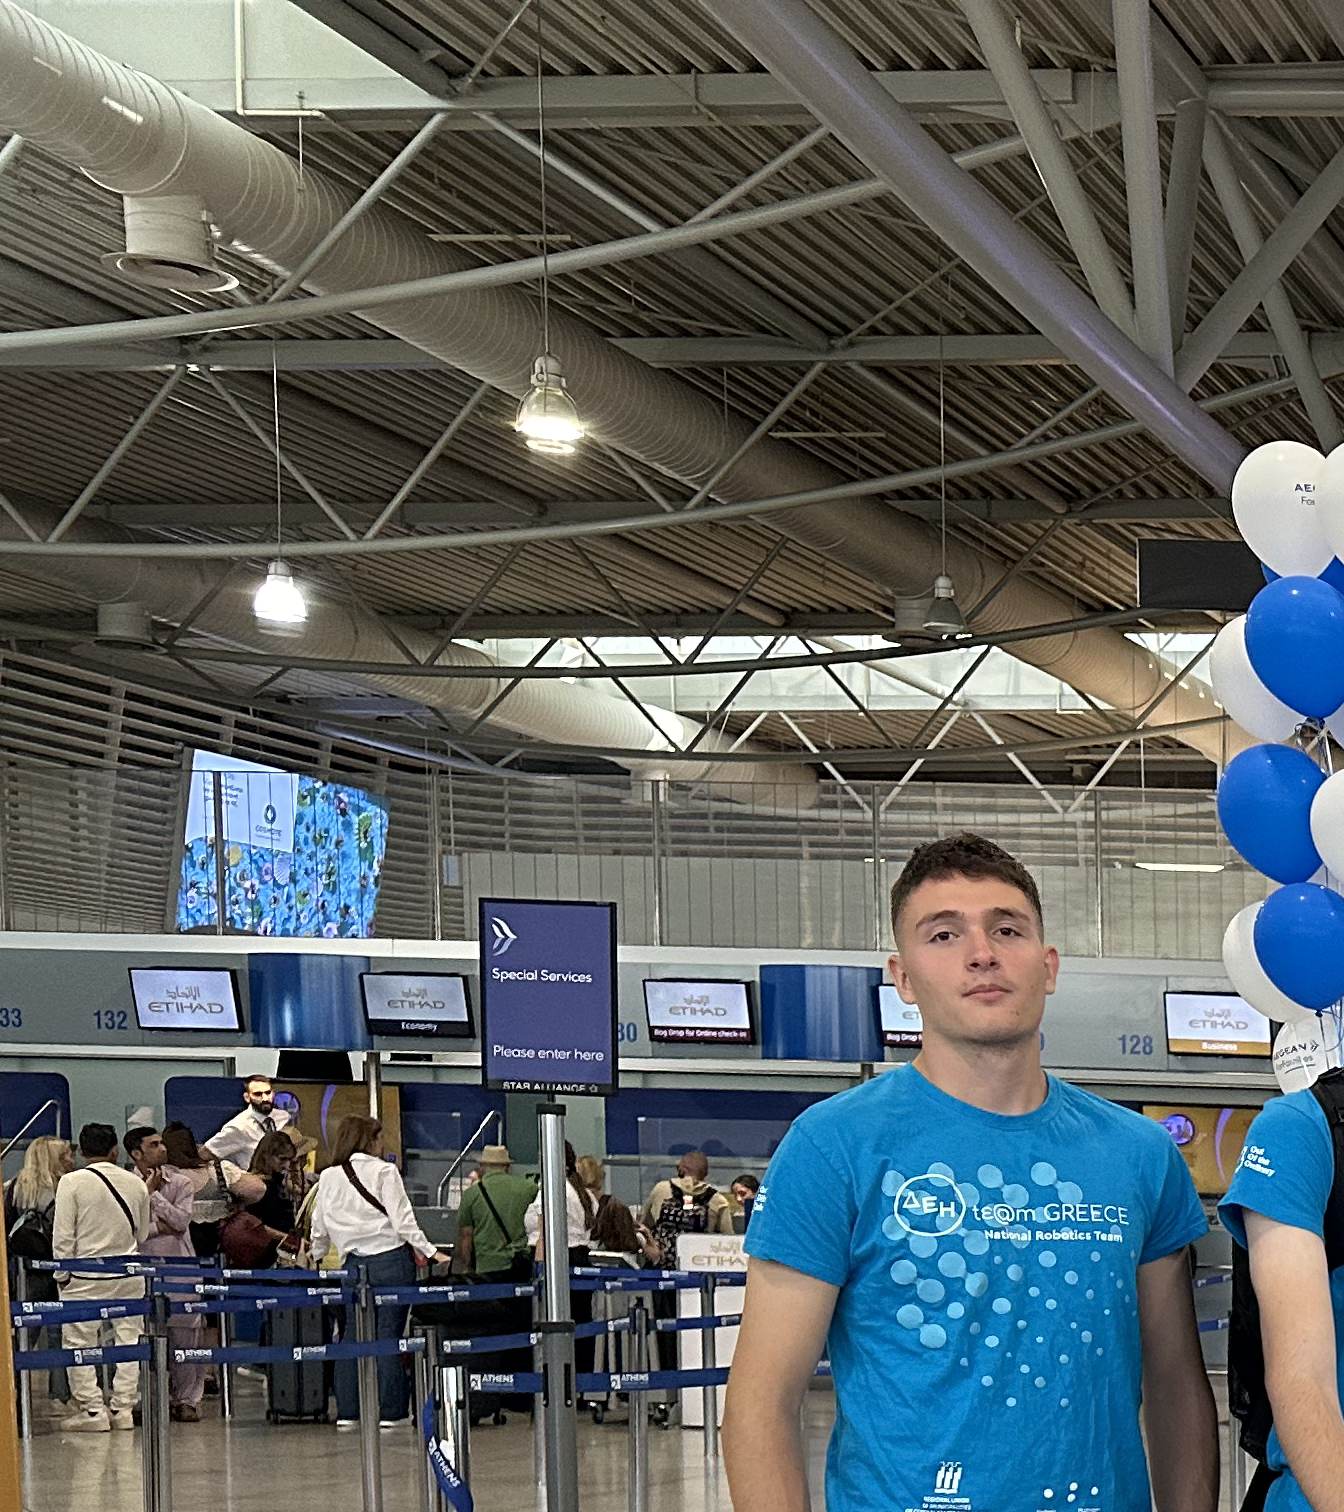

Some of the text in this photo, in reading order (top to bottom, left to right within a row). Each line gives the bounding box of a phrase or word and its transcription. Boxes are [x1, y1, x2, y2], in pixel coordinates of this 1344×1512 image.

[492, 968, 593, 984] Special Services
[148, 1002, 224, 1014] ETIHAD
[387, 999, 445, 1010] ETIHAD
[669, 1006, 728, 1017] ETIHAD
[93, 1010, 128, 1030] 132
[1189, 1019, 1248, 1031] ETIHAD
[1118, 1034, 1154, 1055] 128
[492, 1045, 604, 1061] Please enter here
[1250, 1145, 1265, 1155] Out
[1043, 1203, 1130, 1225] GREECE
[984, 1230, 1123, 1242] National Robotics Team
[482, 1374, 514, 1383] ATHENS
[622, 1374, 648, 1382] ATHENS
